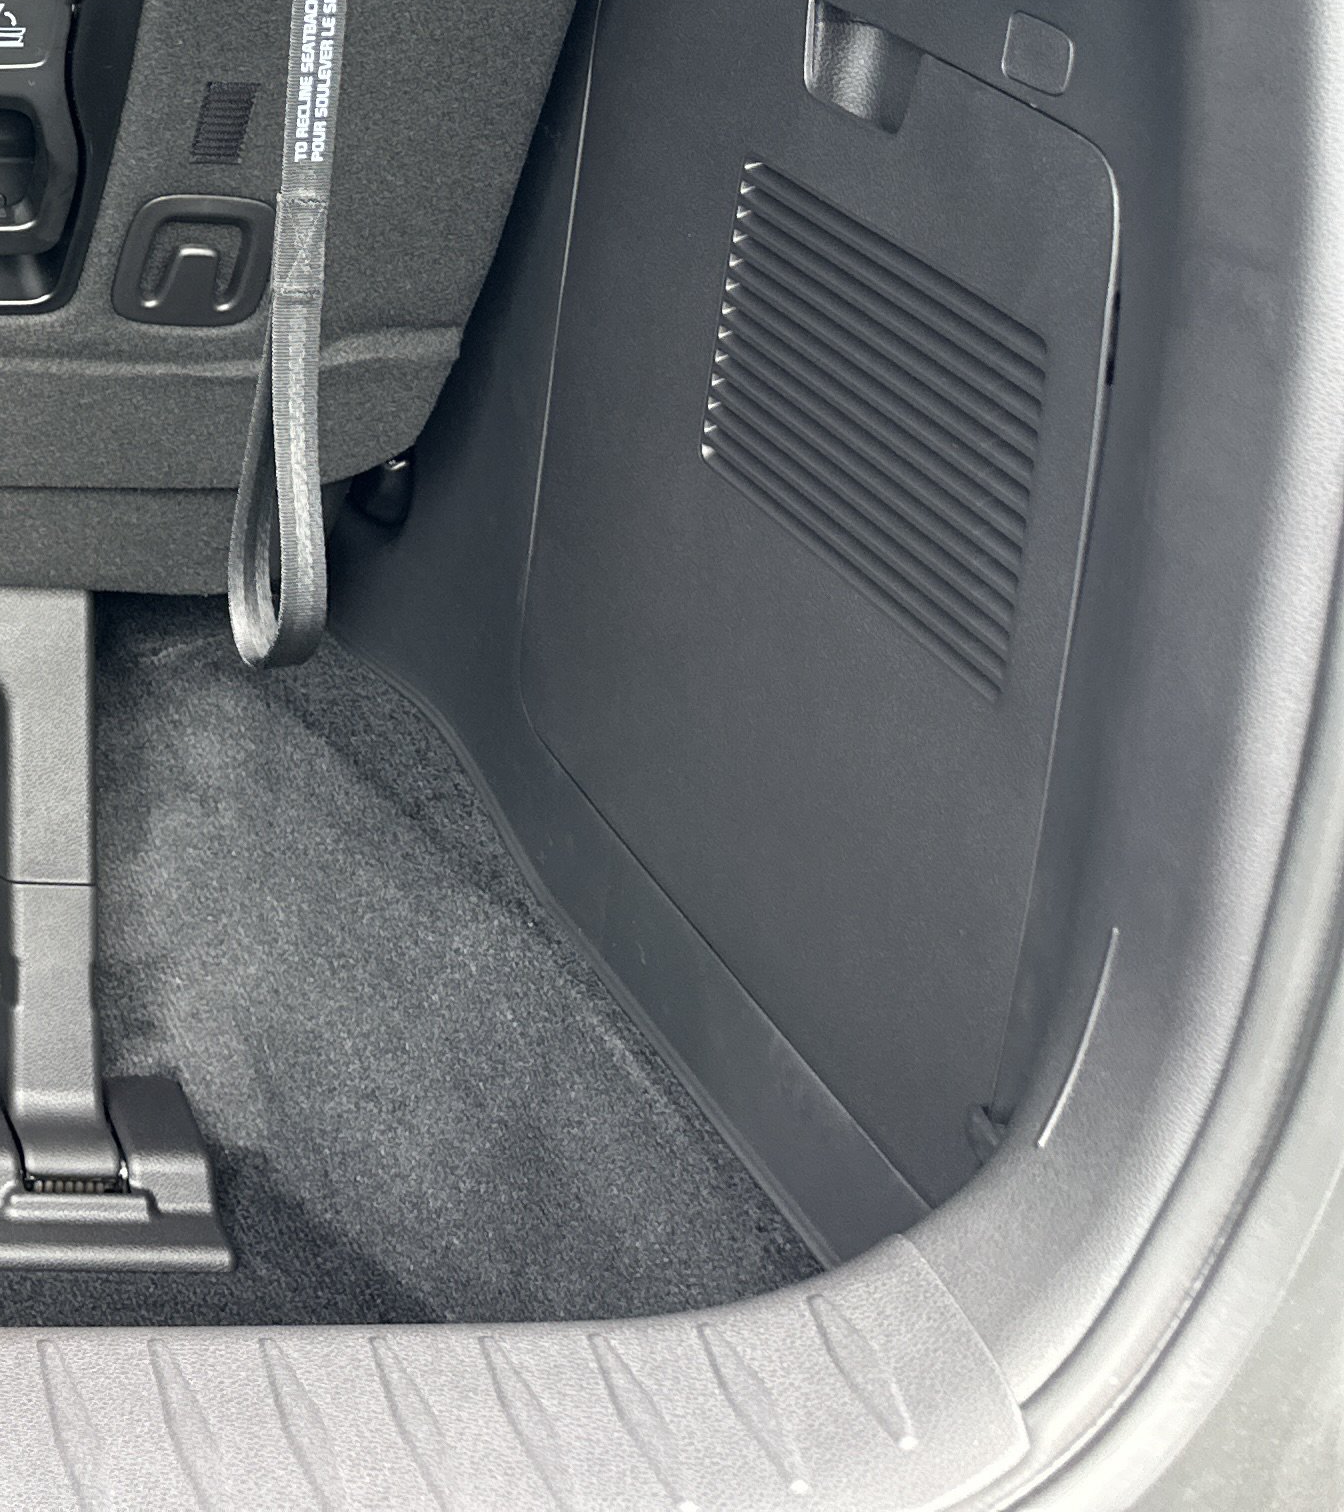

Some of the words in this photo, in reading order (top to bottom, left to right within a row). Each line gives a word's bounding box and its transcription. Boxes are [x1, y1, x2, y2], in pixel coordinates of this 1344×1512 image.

[321, 16, 335, 36] LE
[314, 39, 334, 118] SOULEVER
[296, 76, 314, 138] RECLINE
[294, 141, 308, 162] TO
[311, 120, 327, 162] POUR
